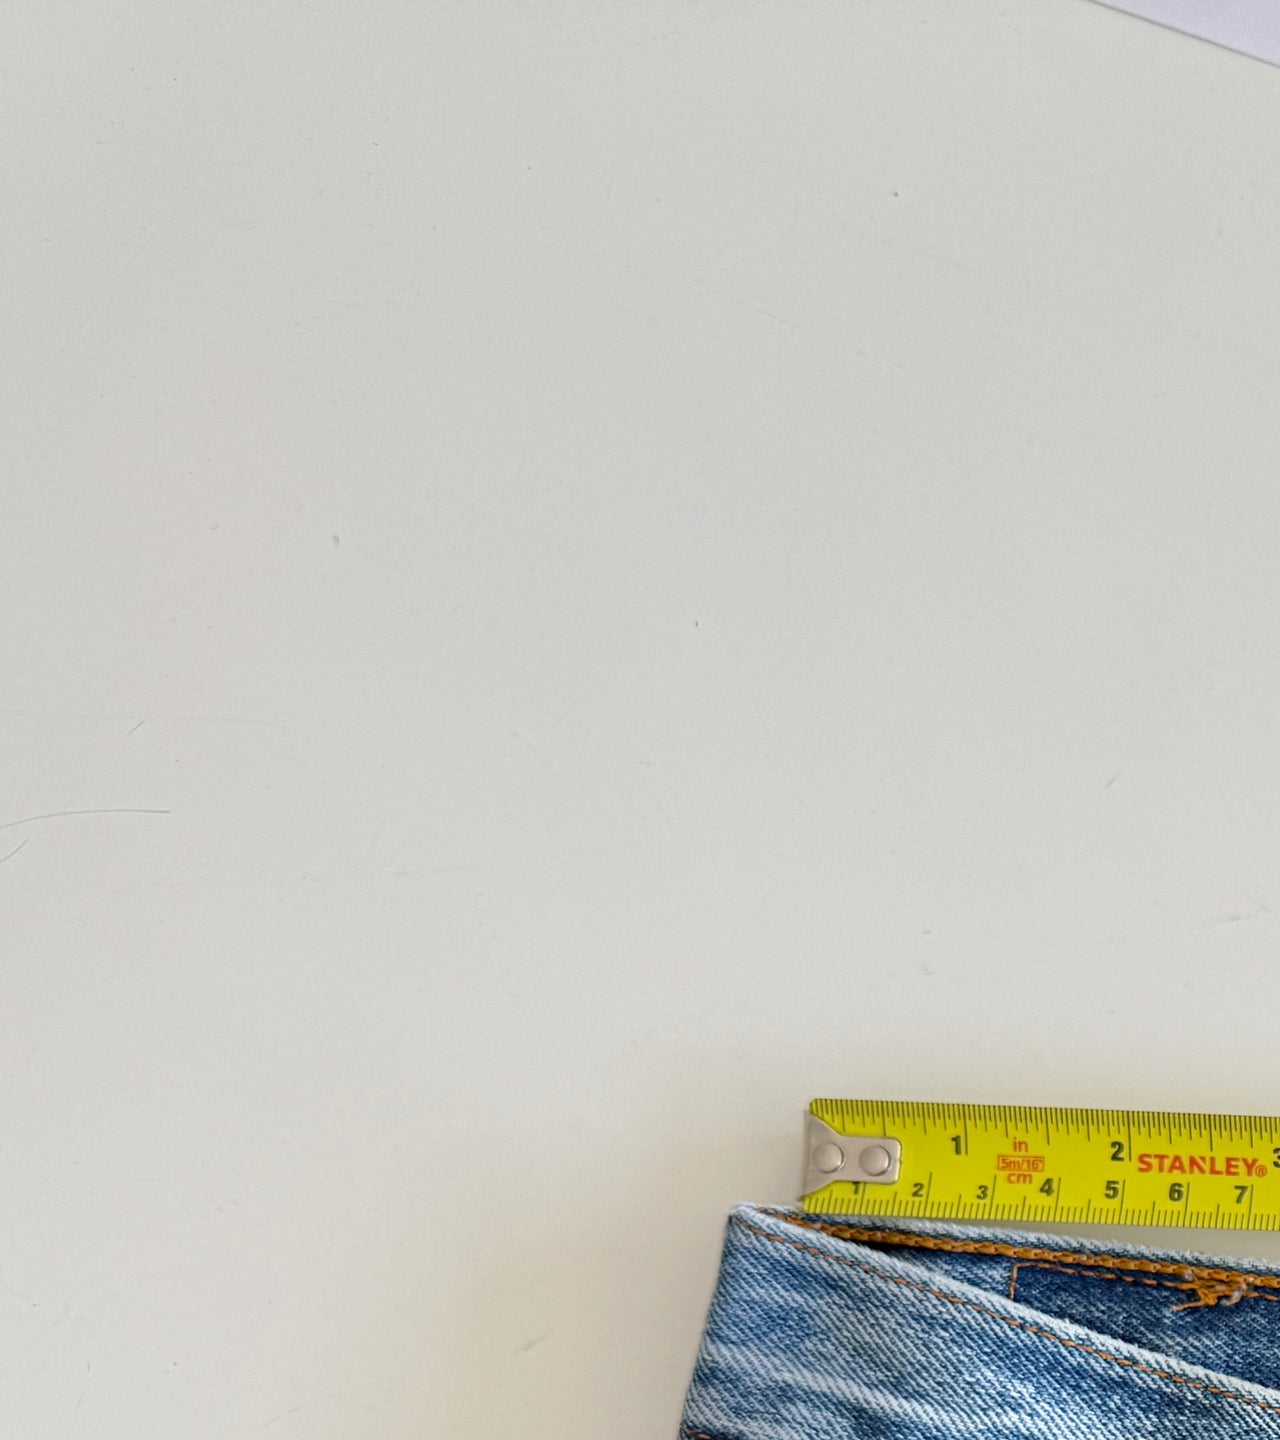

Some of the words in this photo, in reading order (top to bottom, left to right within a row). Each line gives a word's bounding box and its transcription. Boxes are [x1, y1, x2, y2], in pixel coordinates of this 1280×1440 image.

[951, 1136, 962, 1155] 1
[1111, 1142, 1124, 1161] 2
[1013, 1136, 1029, 1152] in
[1007, 1173, 1033, 1184] cm
[912, 1183, 923, 1198] 2
[976, 1185, 988, 1201] 3
[1040, 1179, 1054, 1197] 4
[1105, 1181, 1119, 1200] 5
[1169, 1182, 1183, 1202] 6
[1234, 1186, 1248, 1204] 7
